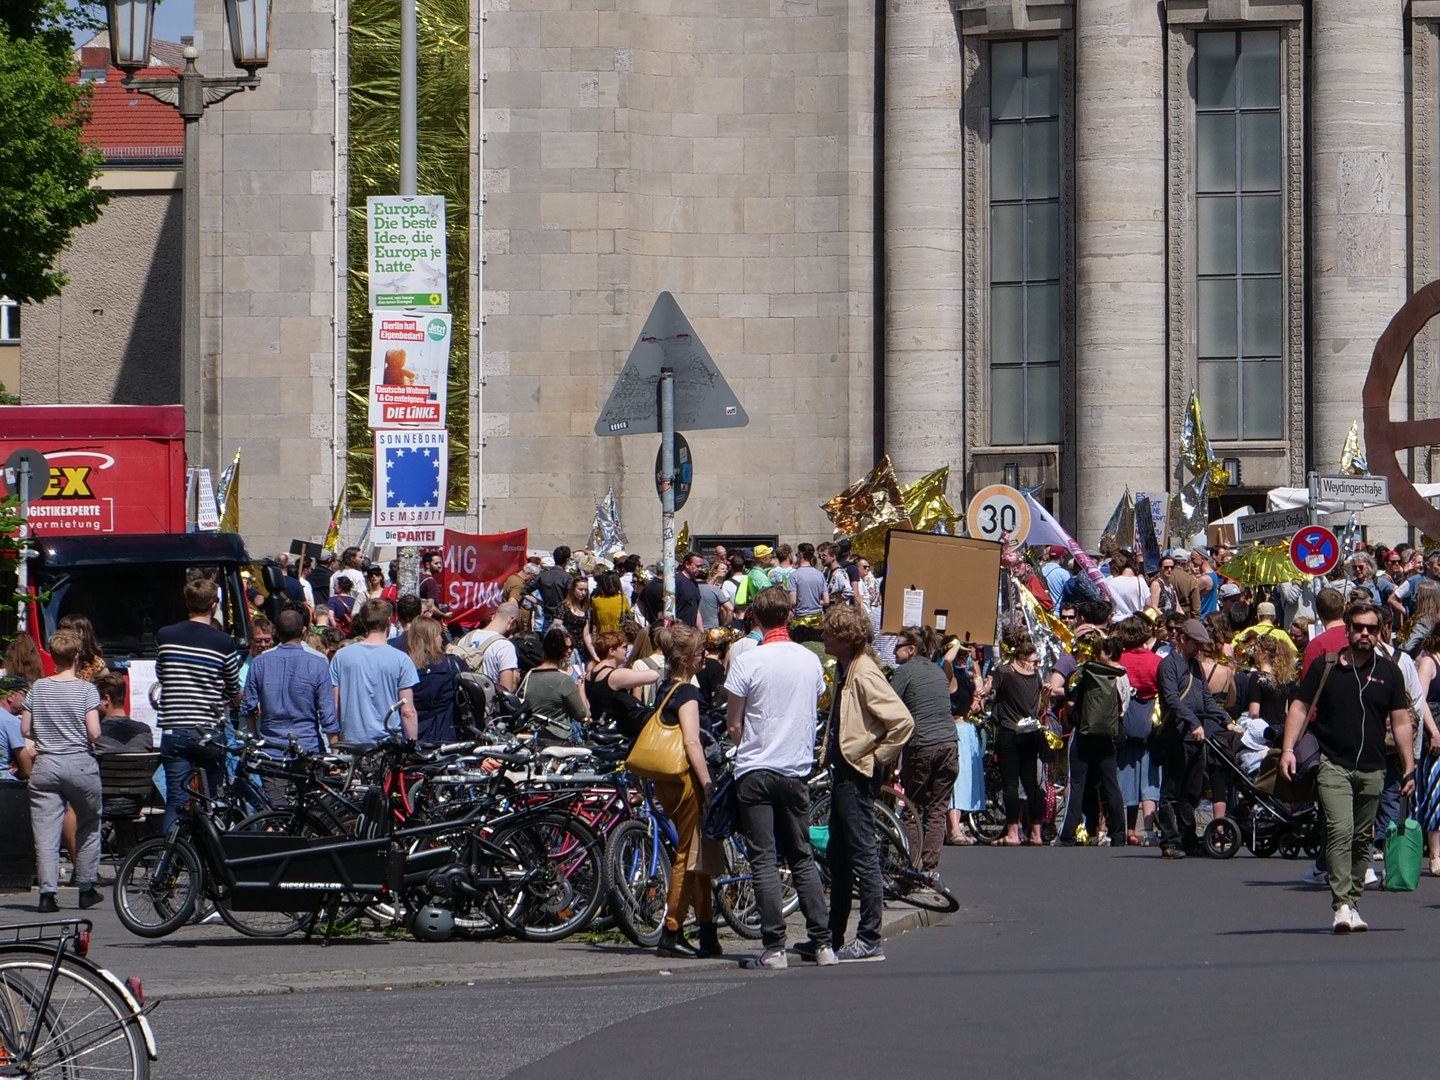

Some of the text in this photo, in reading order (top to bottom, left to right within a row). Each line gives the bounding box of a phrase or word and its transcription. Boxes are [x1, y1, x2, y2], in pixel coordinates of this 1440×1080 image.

[374, 203, 429, 217] Europa.
[374, 217, 437, 229] Die beste
[375, 231, 433, 245] Idee, die
[375, 245, 441, 260] Europa je
[375, 260, 415, 273] hatte.
[383, 322, 415, 330] Berlin hat
[381, 331, 423, 340] Eigenbedarf!
[376, 386, 429, 394] Deutsche Wohnen
[394, 395, 425, 404] enteignen.
[387, 407, 405, 419] DIE
[380, 434, 444, 444] SONNEBORN
[1323, 480, 1383, 497] Weydingerstraße
[381, 511, 441, 521] SEMSROTT
[982, 504, 1016, 534] 30
[397, 531, 435, 542] PARTEI
